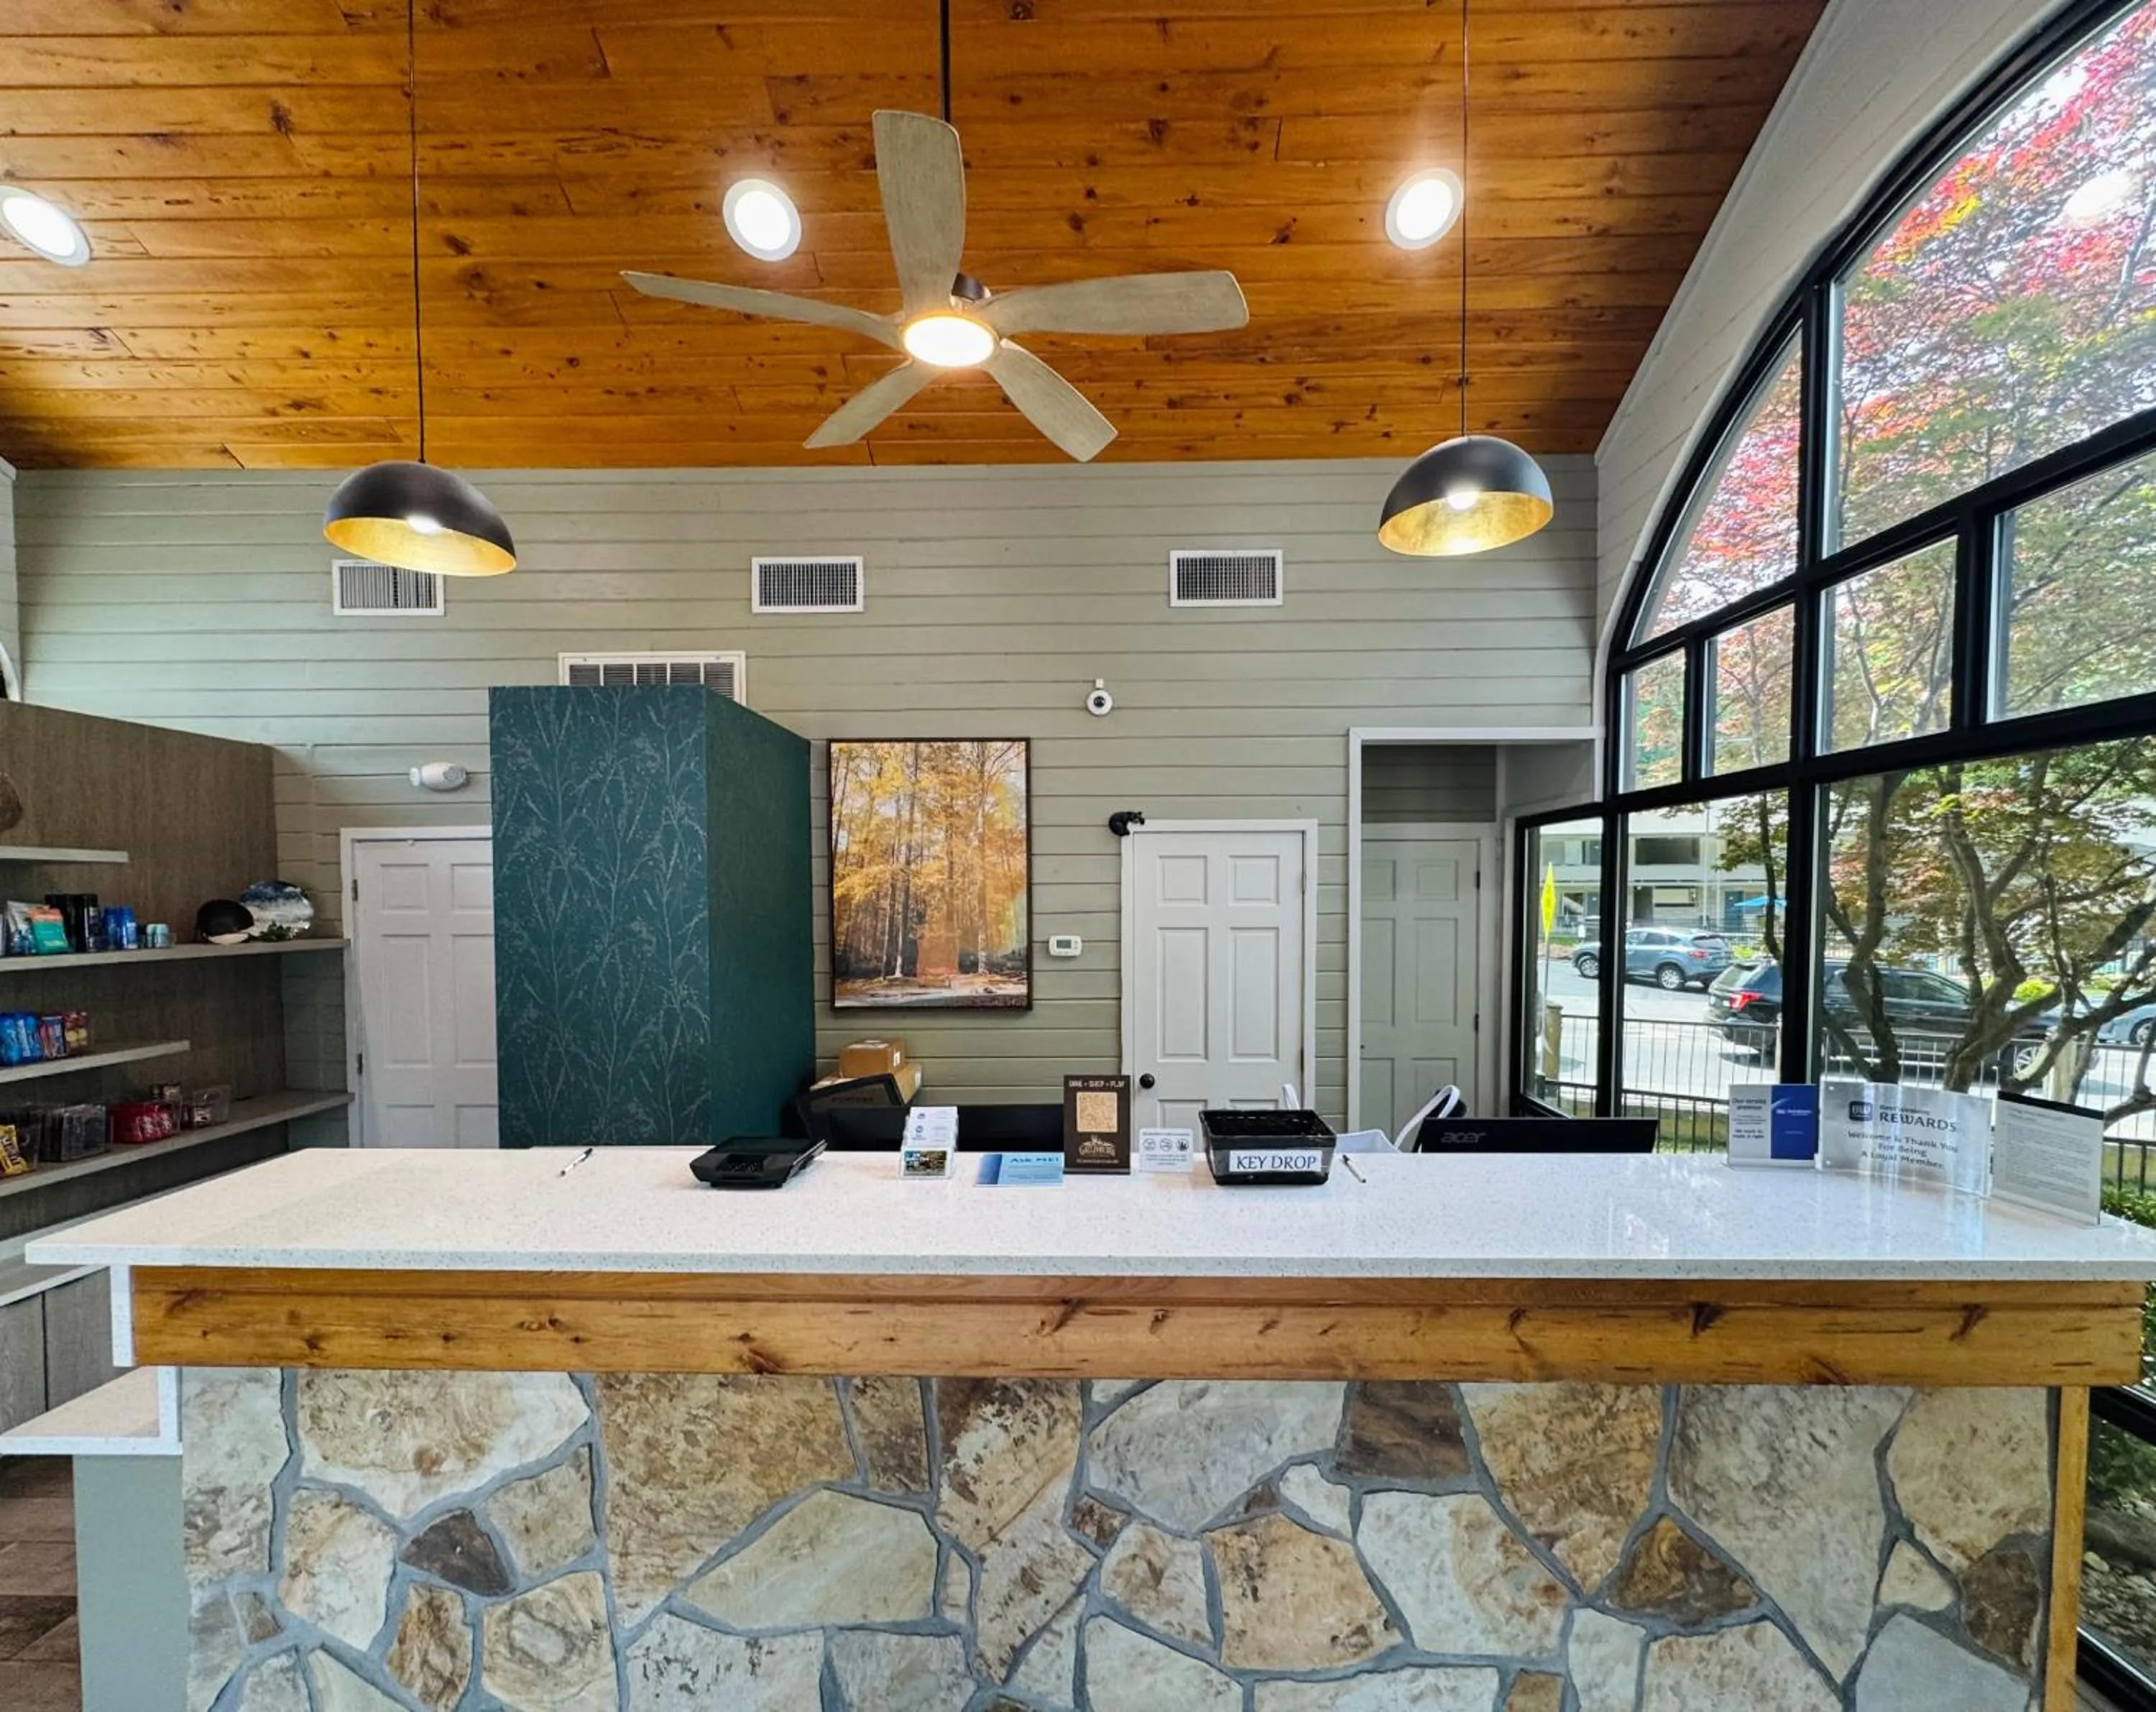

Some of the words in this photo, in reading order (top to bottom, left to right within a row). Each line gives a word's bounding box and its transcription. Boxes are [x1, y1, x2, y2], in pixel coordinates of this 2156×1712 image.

[1879, 1112, 1958, 1133] REWARDS
[1441, 1133, 1487, 1143] acer
[1848, 1131, 1892, 1141] Welcome
[1905, 1136, 1937, 1149] Thank
[1940, 1141, 1959, 1153] You
[1878, 1142, 1896, 1151] For
[1237, 1155, 1267, 1169] KEY
[1271, 1155, 1317, 1169] DROP
[1871, 1151, 1898, 1161] Loyal
